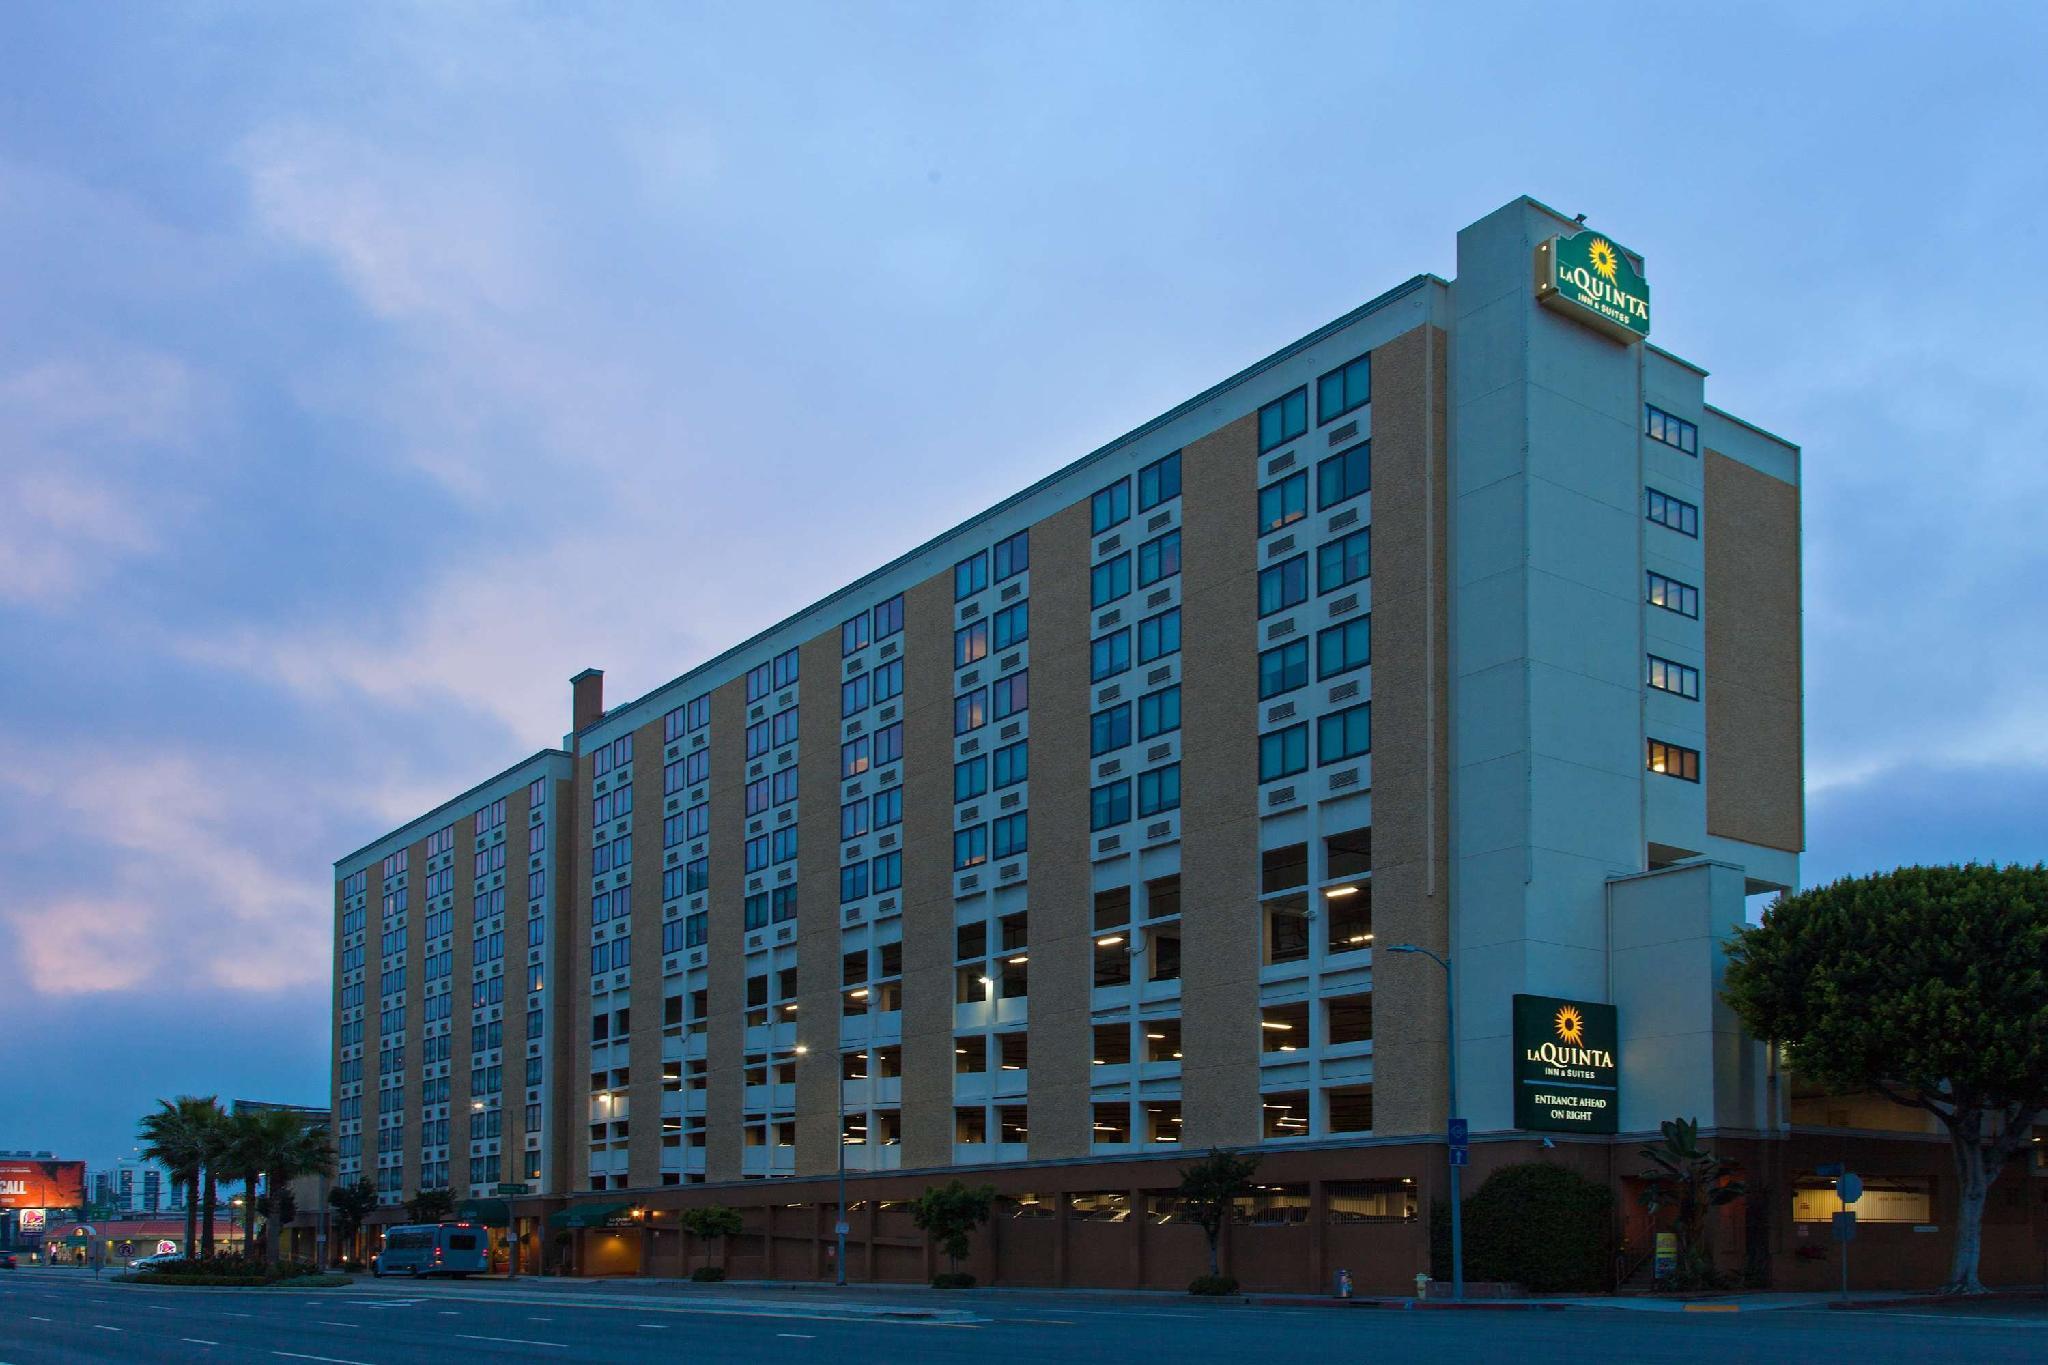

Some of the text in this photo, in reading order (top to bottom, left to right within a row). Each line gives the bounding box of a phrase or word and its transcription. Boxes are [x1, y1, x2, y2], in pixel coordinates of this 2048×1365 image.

[1577, 293, 1593, 306] INN
[1601, 304, 1630, 324] SUITES
[1545, 1067, 1559, 1076] INN
[1567, 1069, 1595, 1079] SUITES
[1535, 1095, 1606, 1108] ENTRANCE AHEAD
[1551, 1110, 1592, 1121] ON RIGHT
